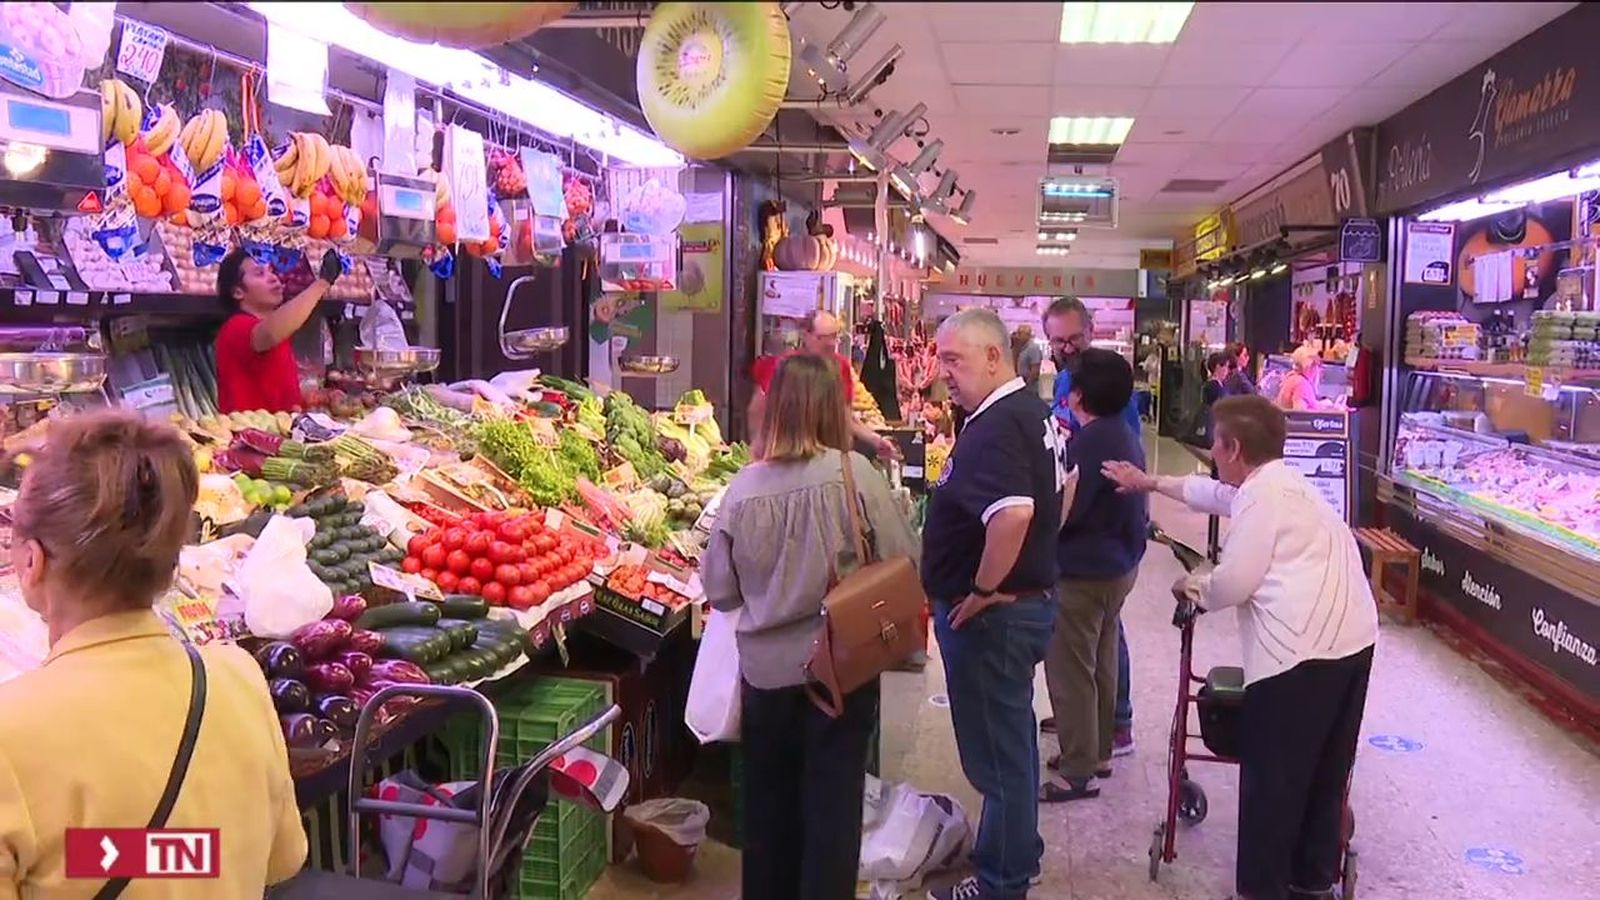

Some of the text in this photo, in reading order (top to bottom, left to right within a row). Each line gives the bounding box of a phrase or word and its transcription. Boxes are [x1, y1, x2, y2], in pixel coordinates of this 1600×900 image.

[1330, 167, 1351, 214] 70
[1461, 569, 1503, 612] Atención
[1531, 606, 1598, 667] Confianza
